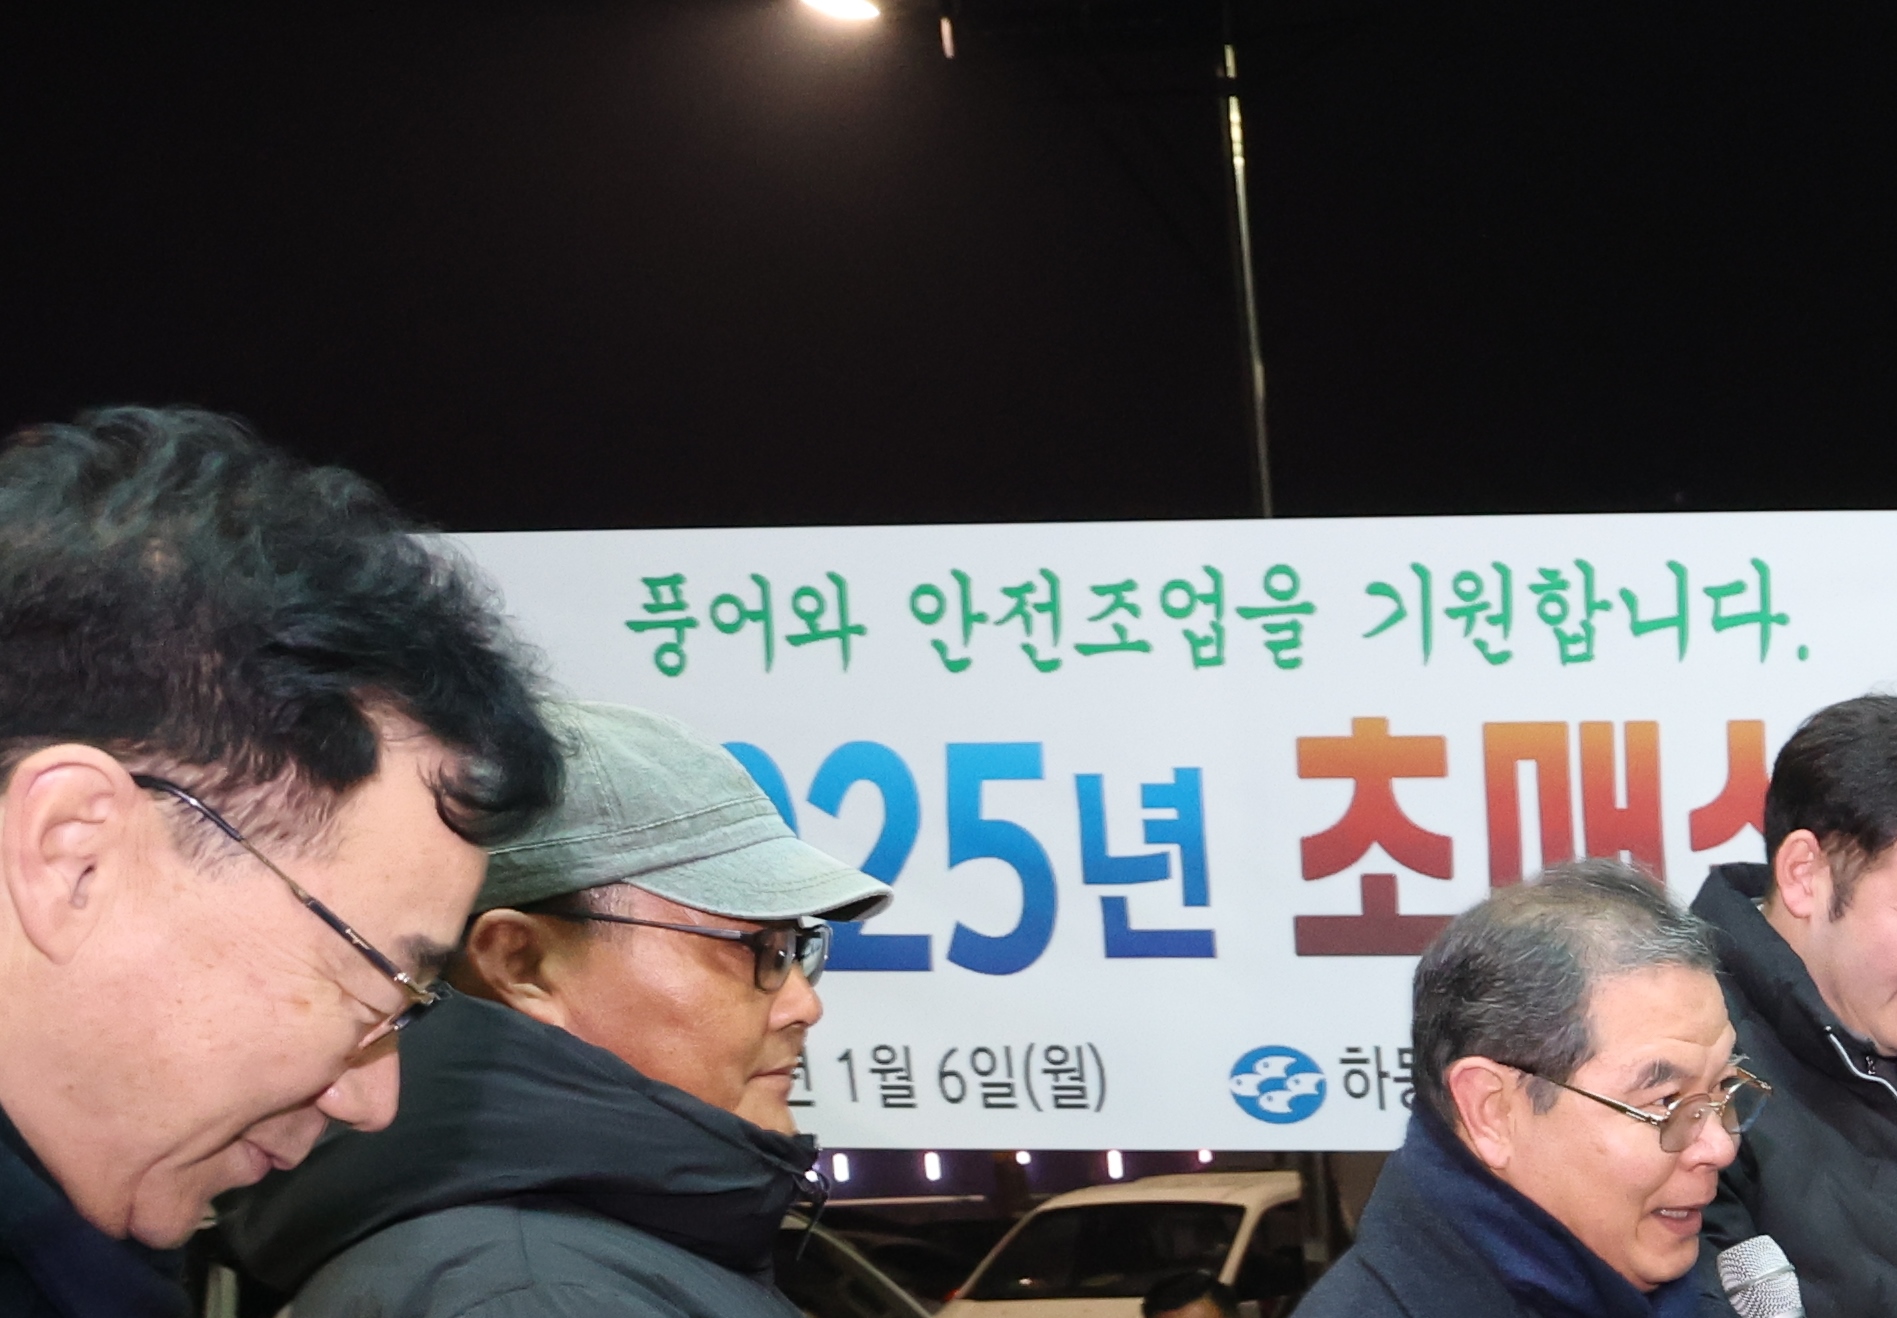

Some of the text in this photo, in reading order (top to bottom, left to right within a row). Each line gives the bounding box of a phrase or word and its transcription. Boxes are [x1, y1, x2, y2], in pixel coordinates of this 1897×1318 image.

[625, 556, 1811, 676] 풍어와 안전조업을 기원합니다.
[722, 738, 1218, 976] 25년
[836, 1043, 918, 1110] 1월
[937, 1041, 1108, 1113] 6일(월)
